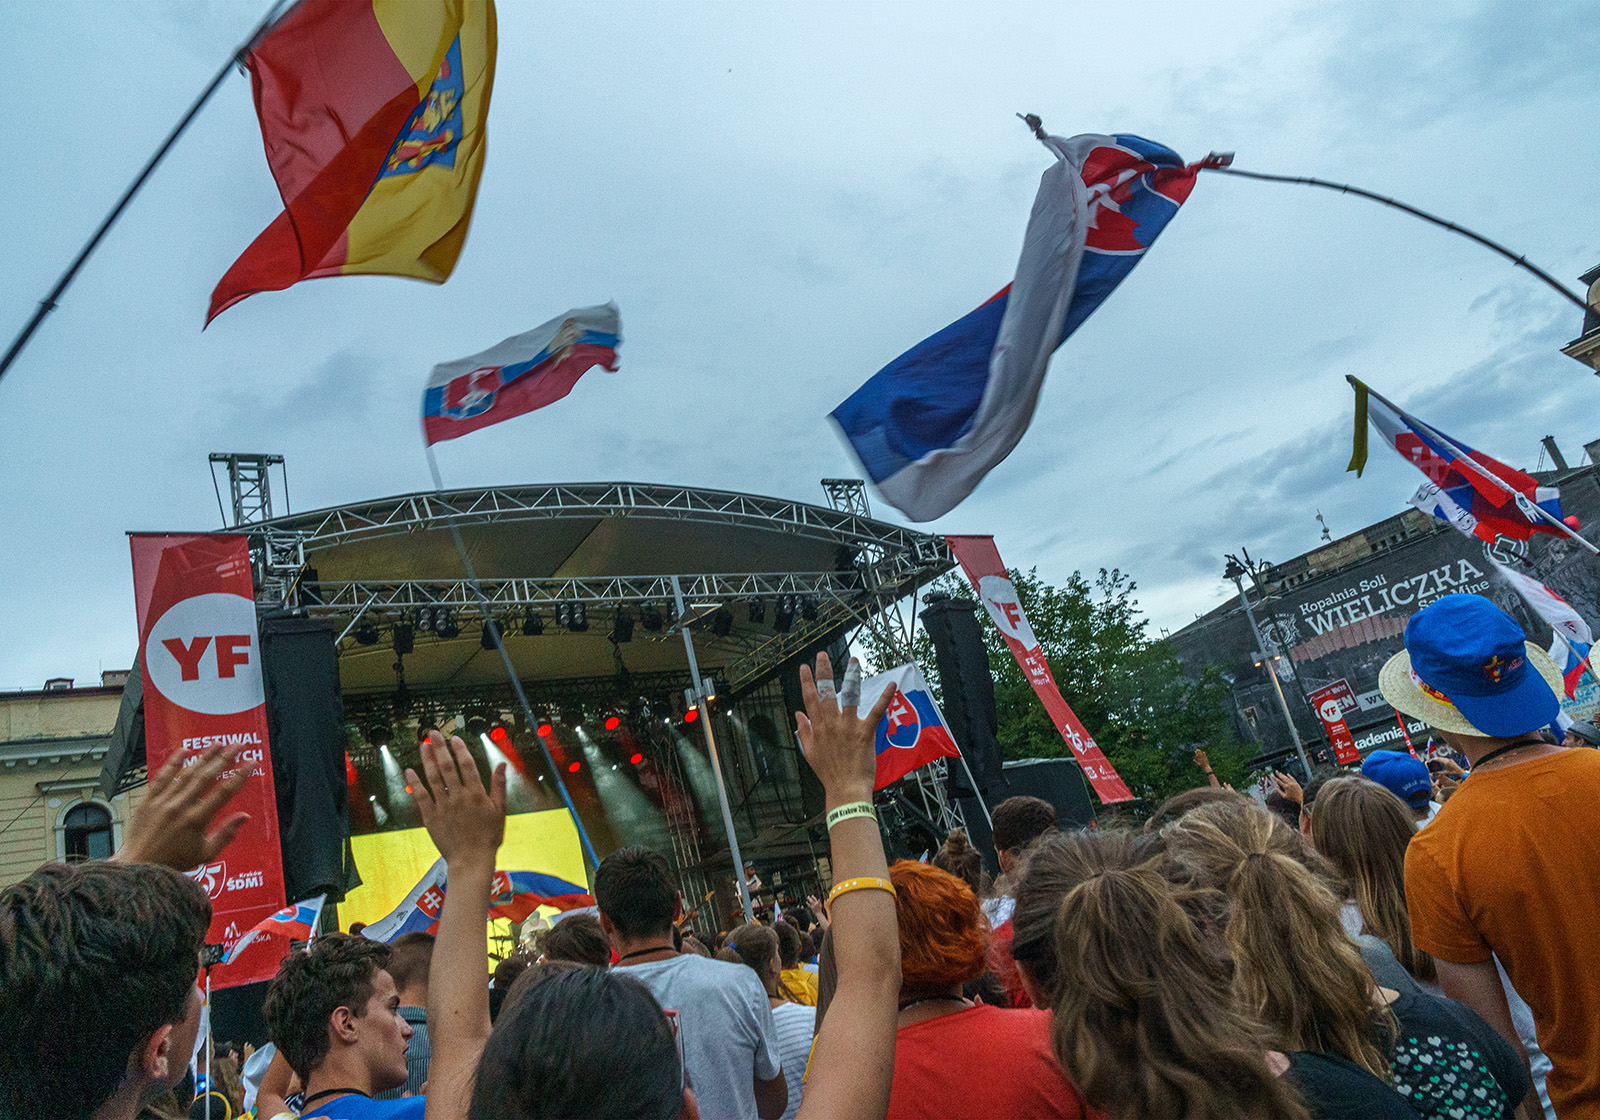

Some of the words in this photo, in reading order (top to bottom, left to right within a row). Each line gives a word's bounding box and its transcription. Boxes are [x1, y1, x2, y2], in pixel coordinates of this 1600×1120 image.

[1299, 587, 1358, 616] Kopalnia
[1359, 574, 1388, 593] Soli
[1305, 558, 1484, 636] WIELICZKA
[161, 634, 252, 682] YF
[1323, 706, 1337, 718] YF
[182, 732, 262, 750] FESTIWAL
